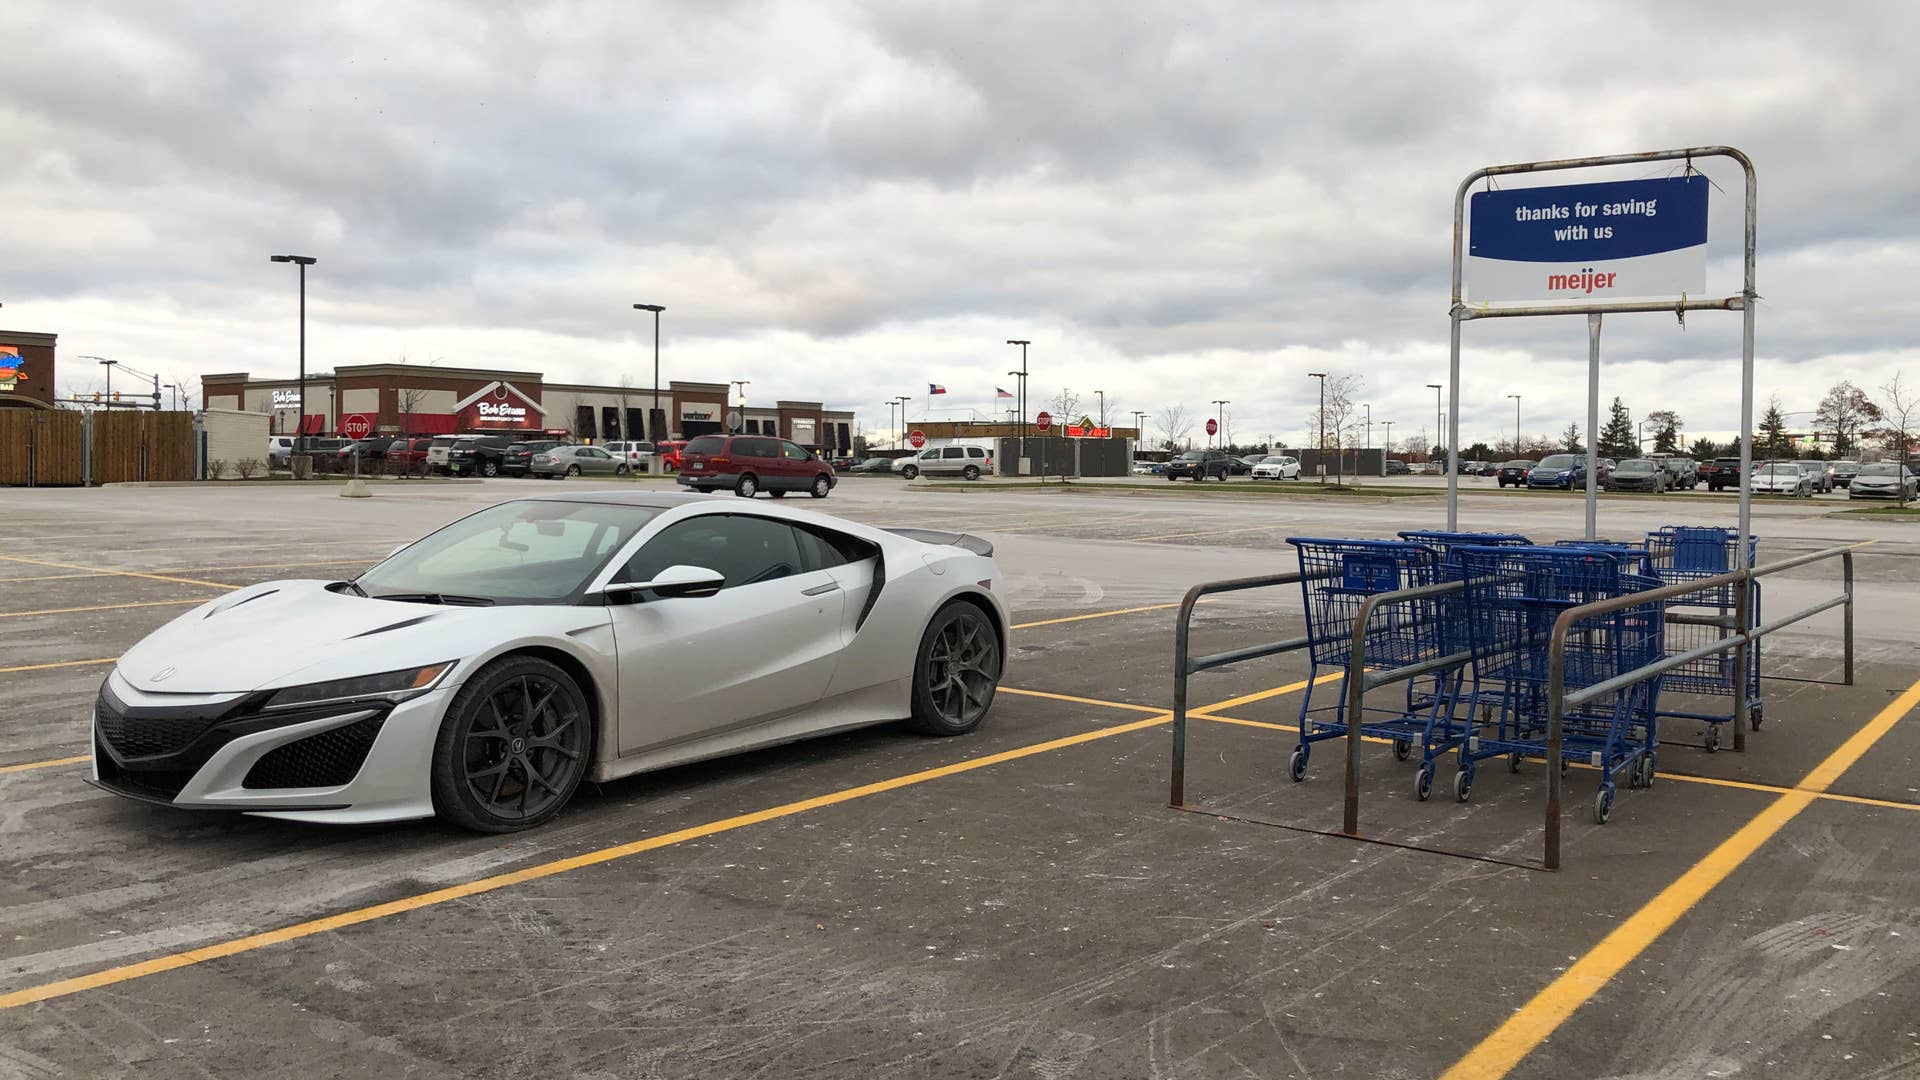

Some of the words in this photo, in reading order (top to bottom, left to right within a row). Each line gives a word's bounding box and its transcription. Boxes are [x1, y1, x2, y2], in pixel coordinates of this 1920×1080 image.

[1515, 204, 1570, 222] thanks
[1575, 202, 1596, 218] for
[1602, 198, 1657, 217] saving
[1554, 224, 1588, 242] with
[1594, 225, 1613, 239] us
[1548, 267, 1617, 294] meijer
[476, 402, 499, 415] Bob
[499, 402, 526, 416] Evans
[682, 411, 711, 421] verizon
[1037, 417, 1051, 425] STOP
[346, 422, 369, 433] STOP
[910, 435, 925, 443] STOP
